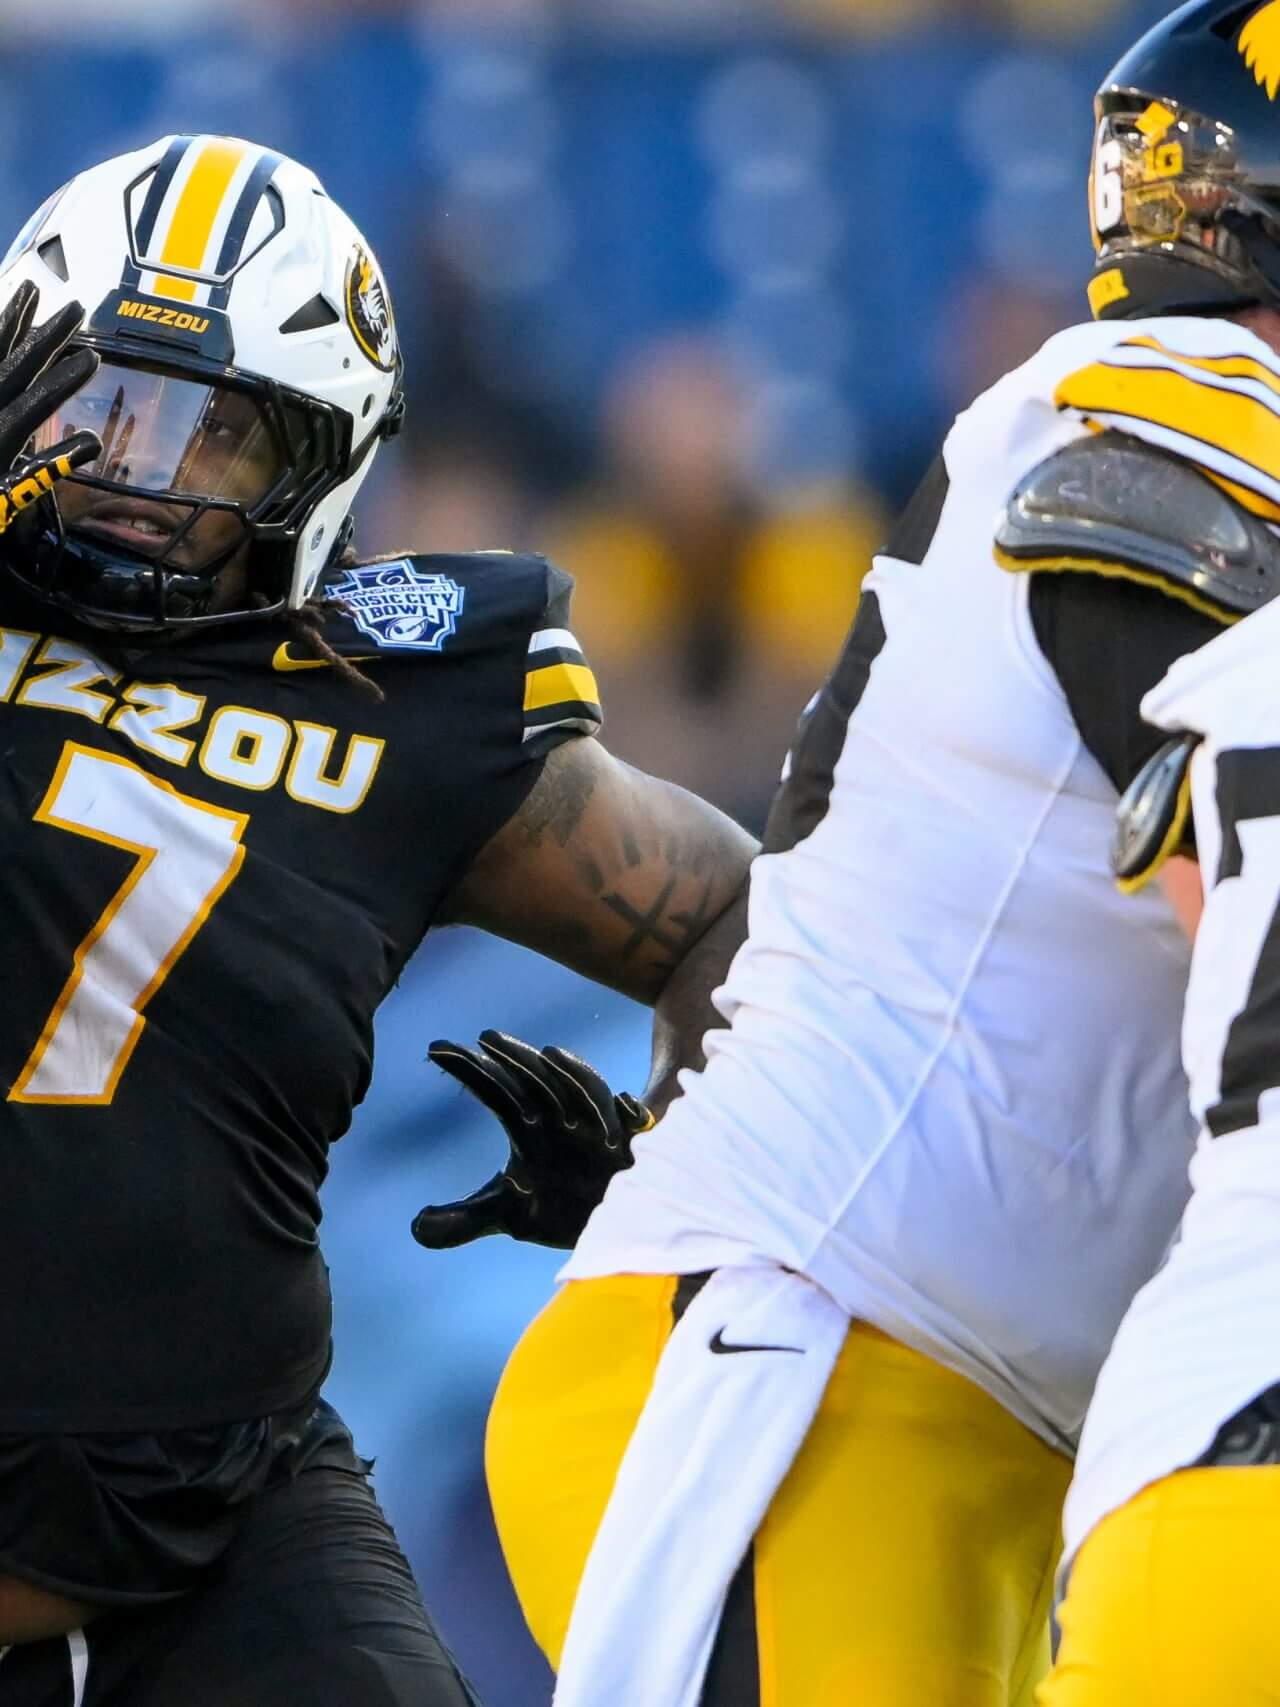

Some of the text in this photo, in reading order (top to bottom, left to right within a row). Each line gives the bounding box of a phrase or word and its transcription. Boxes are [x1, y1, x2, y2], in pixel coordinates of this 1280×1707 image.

[116, 300, 210, 334] MIZZOU
[368, 604, 436, 619] BOWL
[404, 592, 454, 608] CITY
[6, 739, 251, 1105] 7
